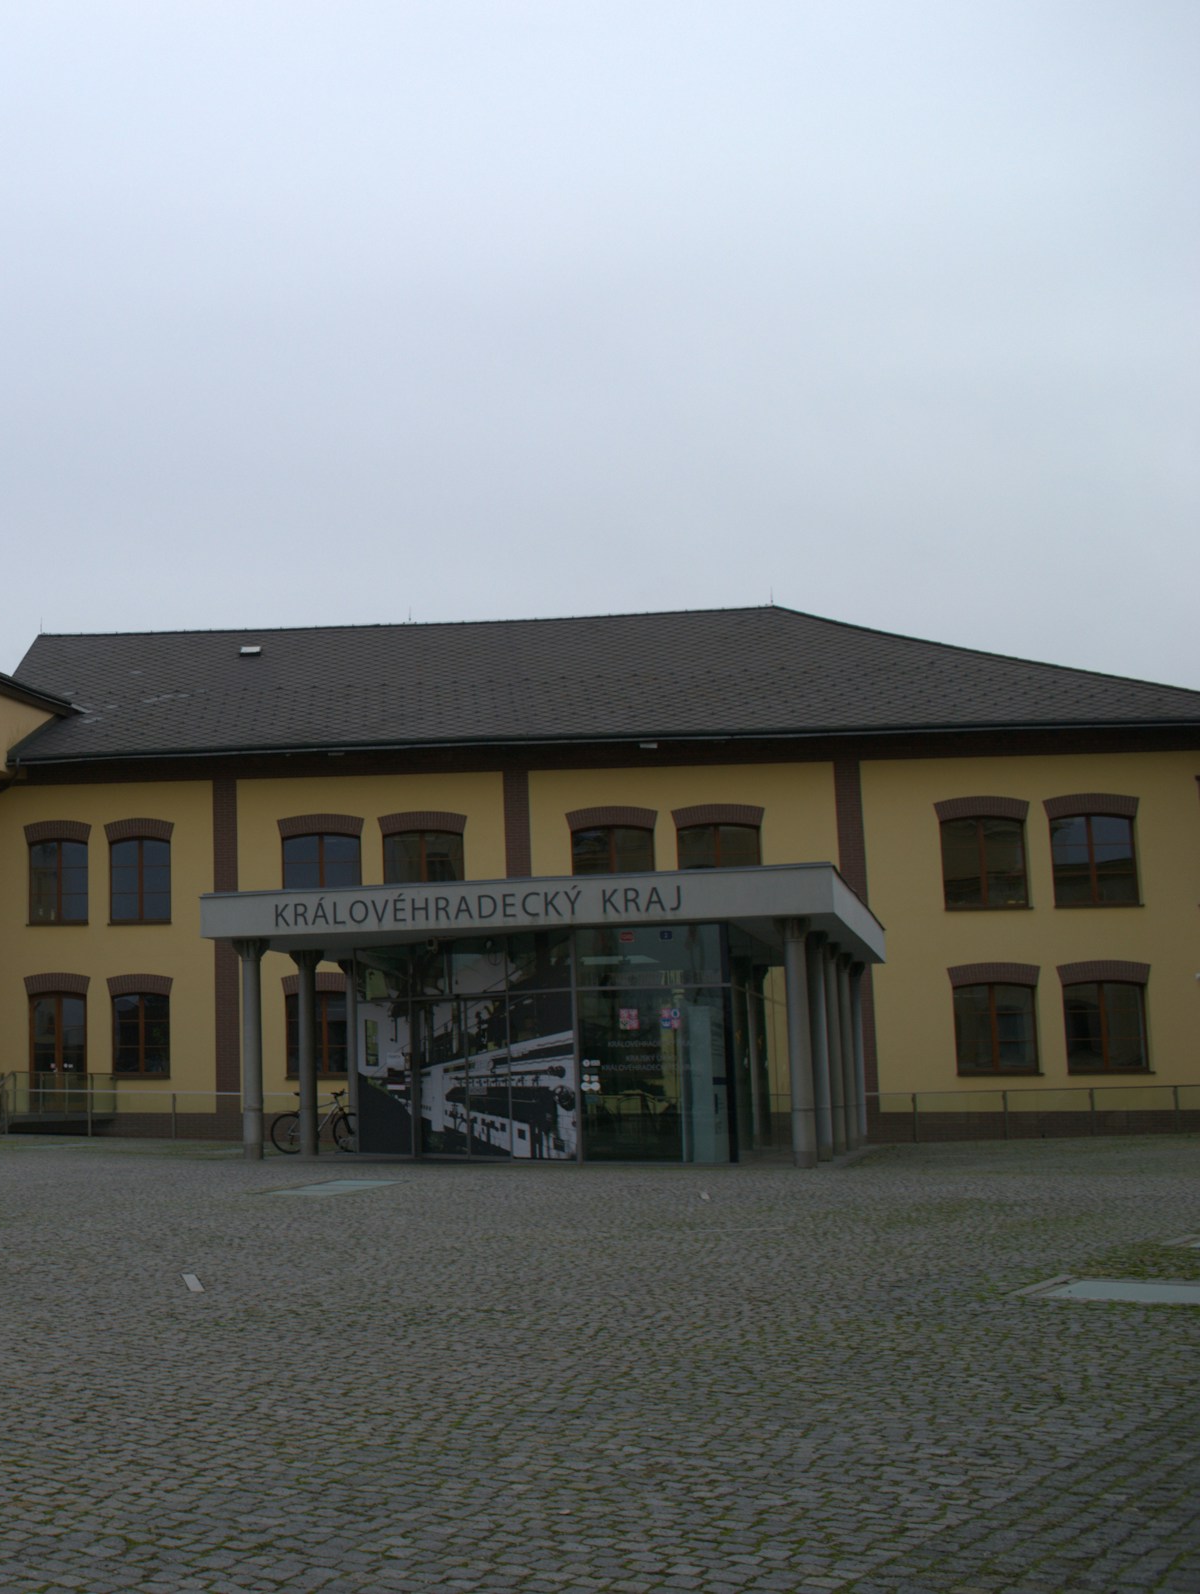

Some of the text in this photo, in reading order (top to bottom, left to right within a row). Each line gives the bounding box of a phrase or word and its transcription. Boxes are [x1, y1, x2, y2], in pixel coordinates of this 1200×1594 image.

[275, 885, 682, 927] KRÁLOVÉHRADECKÝ KRAJ
[607, 1040, 676, 1048] KRÁLOVÉHRAD
[601, 1063, 679, 1072] KRÁLOVÉHRADEC
